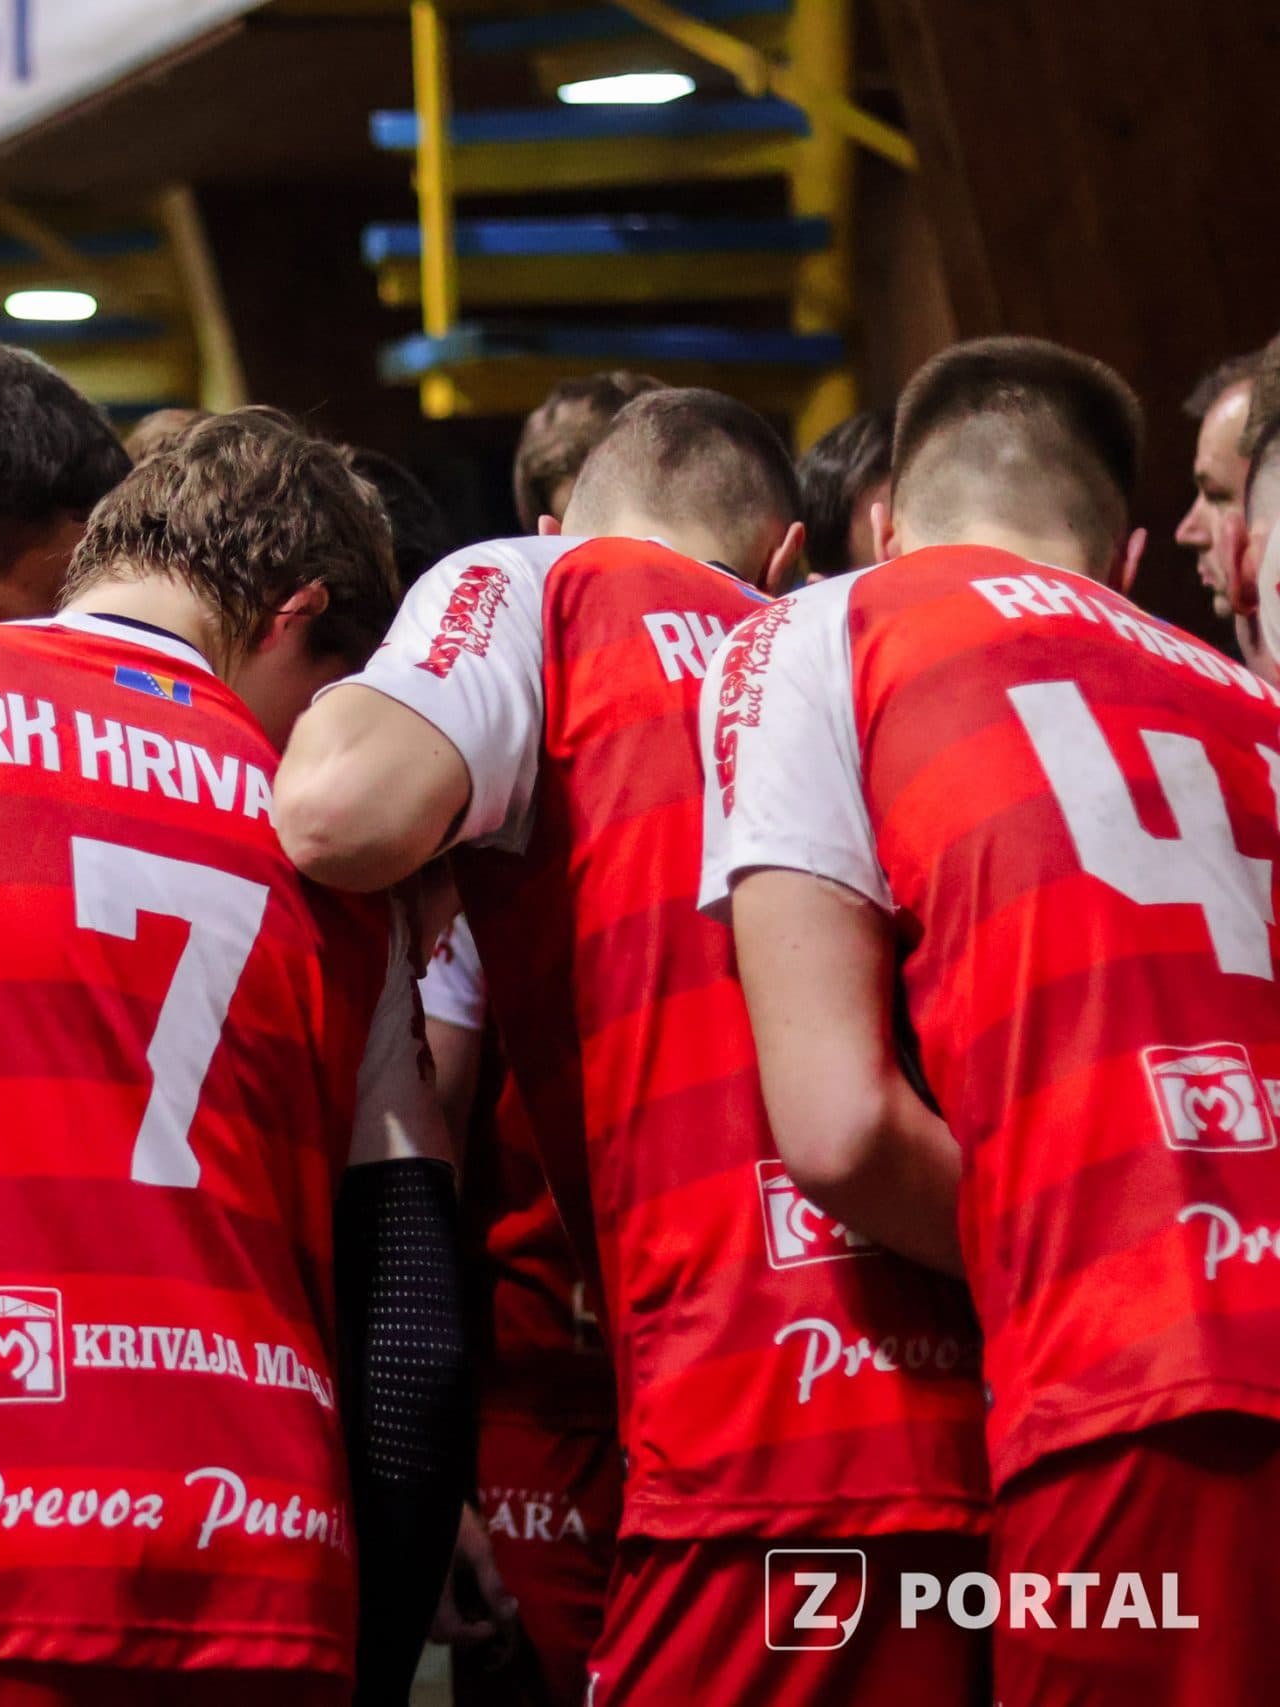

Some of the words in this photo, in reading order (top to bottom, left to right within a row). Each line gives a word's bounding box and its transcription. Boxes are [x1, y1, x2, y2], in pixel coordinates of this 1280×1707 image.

[71, 836, 270, 1190] 7
[72, 1324, 249, 1381] KRIVAJA
[184, 1466, 350, 1555] Putni
